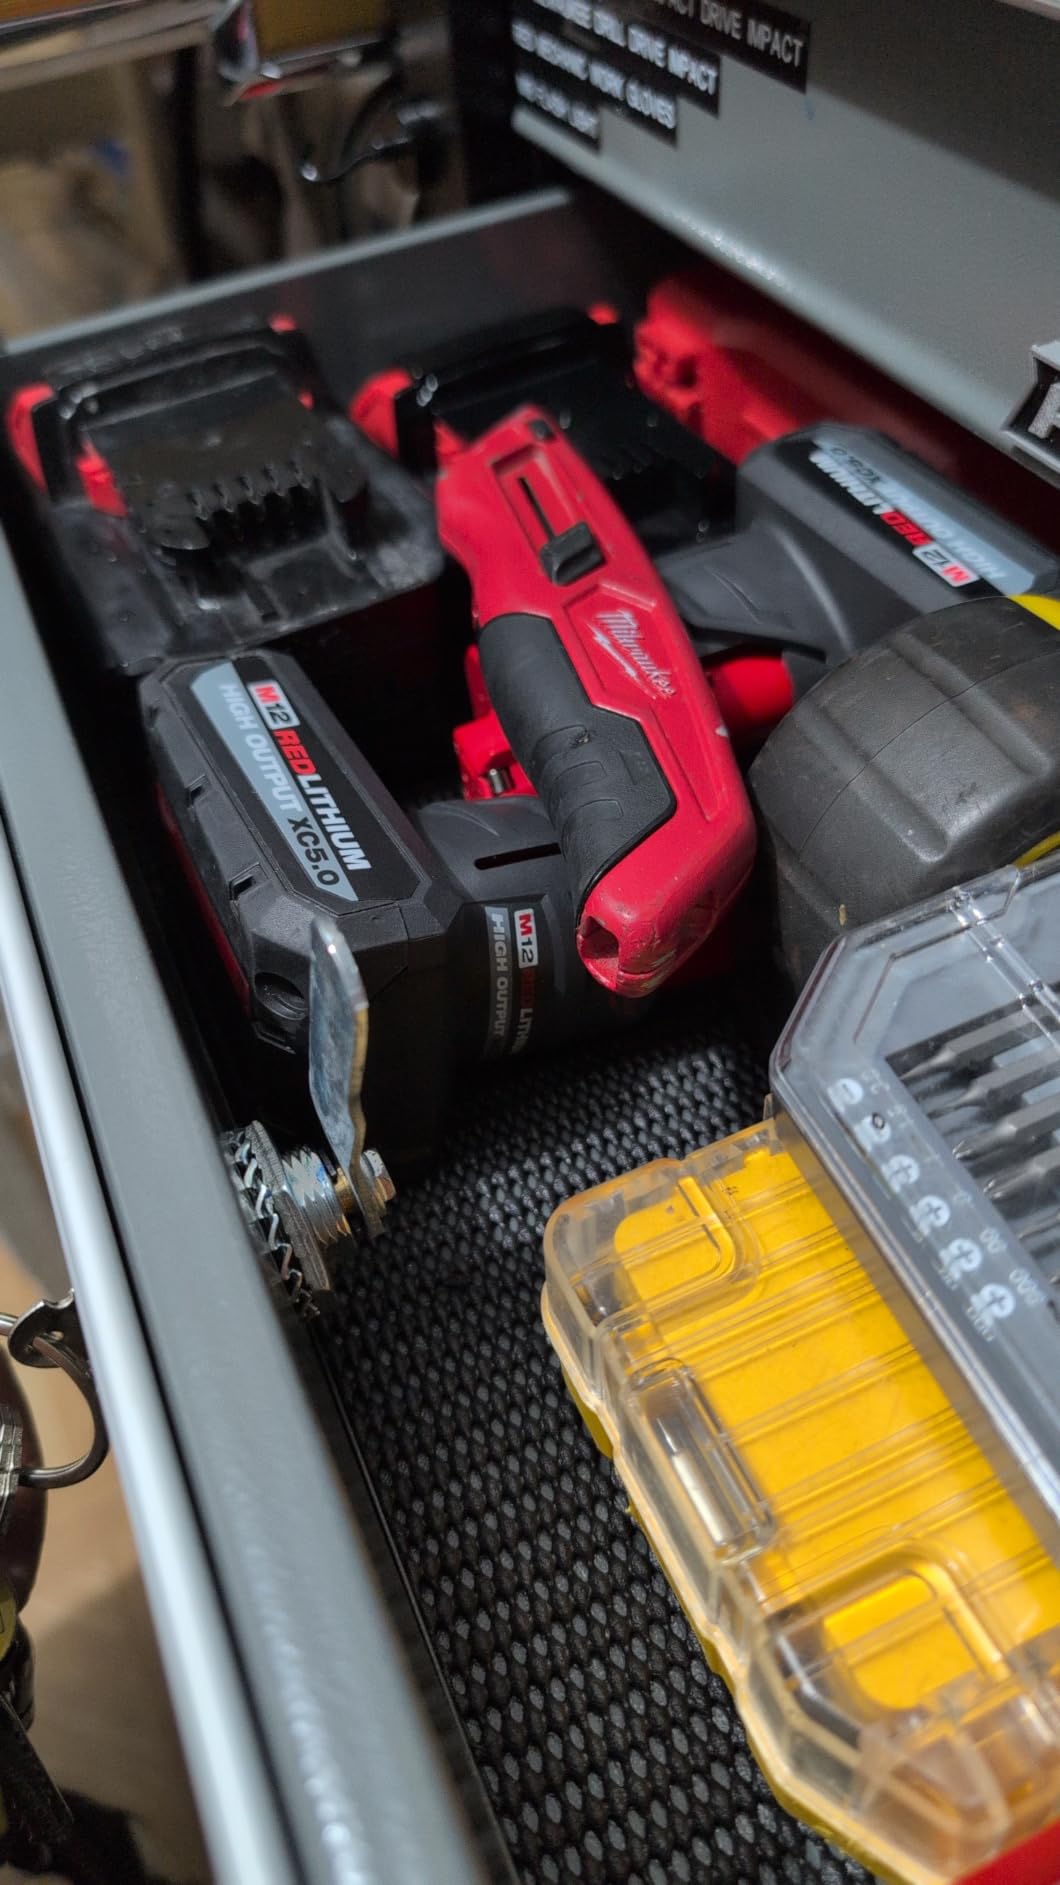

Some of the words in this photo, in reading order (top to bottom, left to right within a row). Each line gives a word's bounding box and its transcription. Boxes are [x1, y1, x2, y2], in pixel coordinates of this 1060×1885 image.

[700, 0, 742, 40] DRIVE
[746, 17, 804, 68] IMPACT
[667, 47, 718, 96] IMPACT
[626, 79, 677, 130] GLOVES
[923, 549, 970, 585] M12
[594, 609, 677, 699] Milwaukee
[218, 683, 255, 731] HIGH
[244, 732, 303, 813] OUTPUT
[287, 815, 340, 887] XC5.0
[253, 683, 291, 725] M12
[272, 728, 372, 871] REDLITHIUM
[491, 912, 508, 972] HIGH
[518, 912, 535, 964] M12
[493, 976, 509, 1037] OUTPUT
